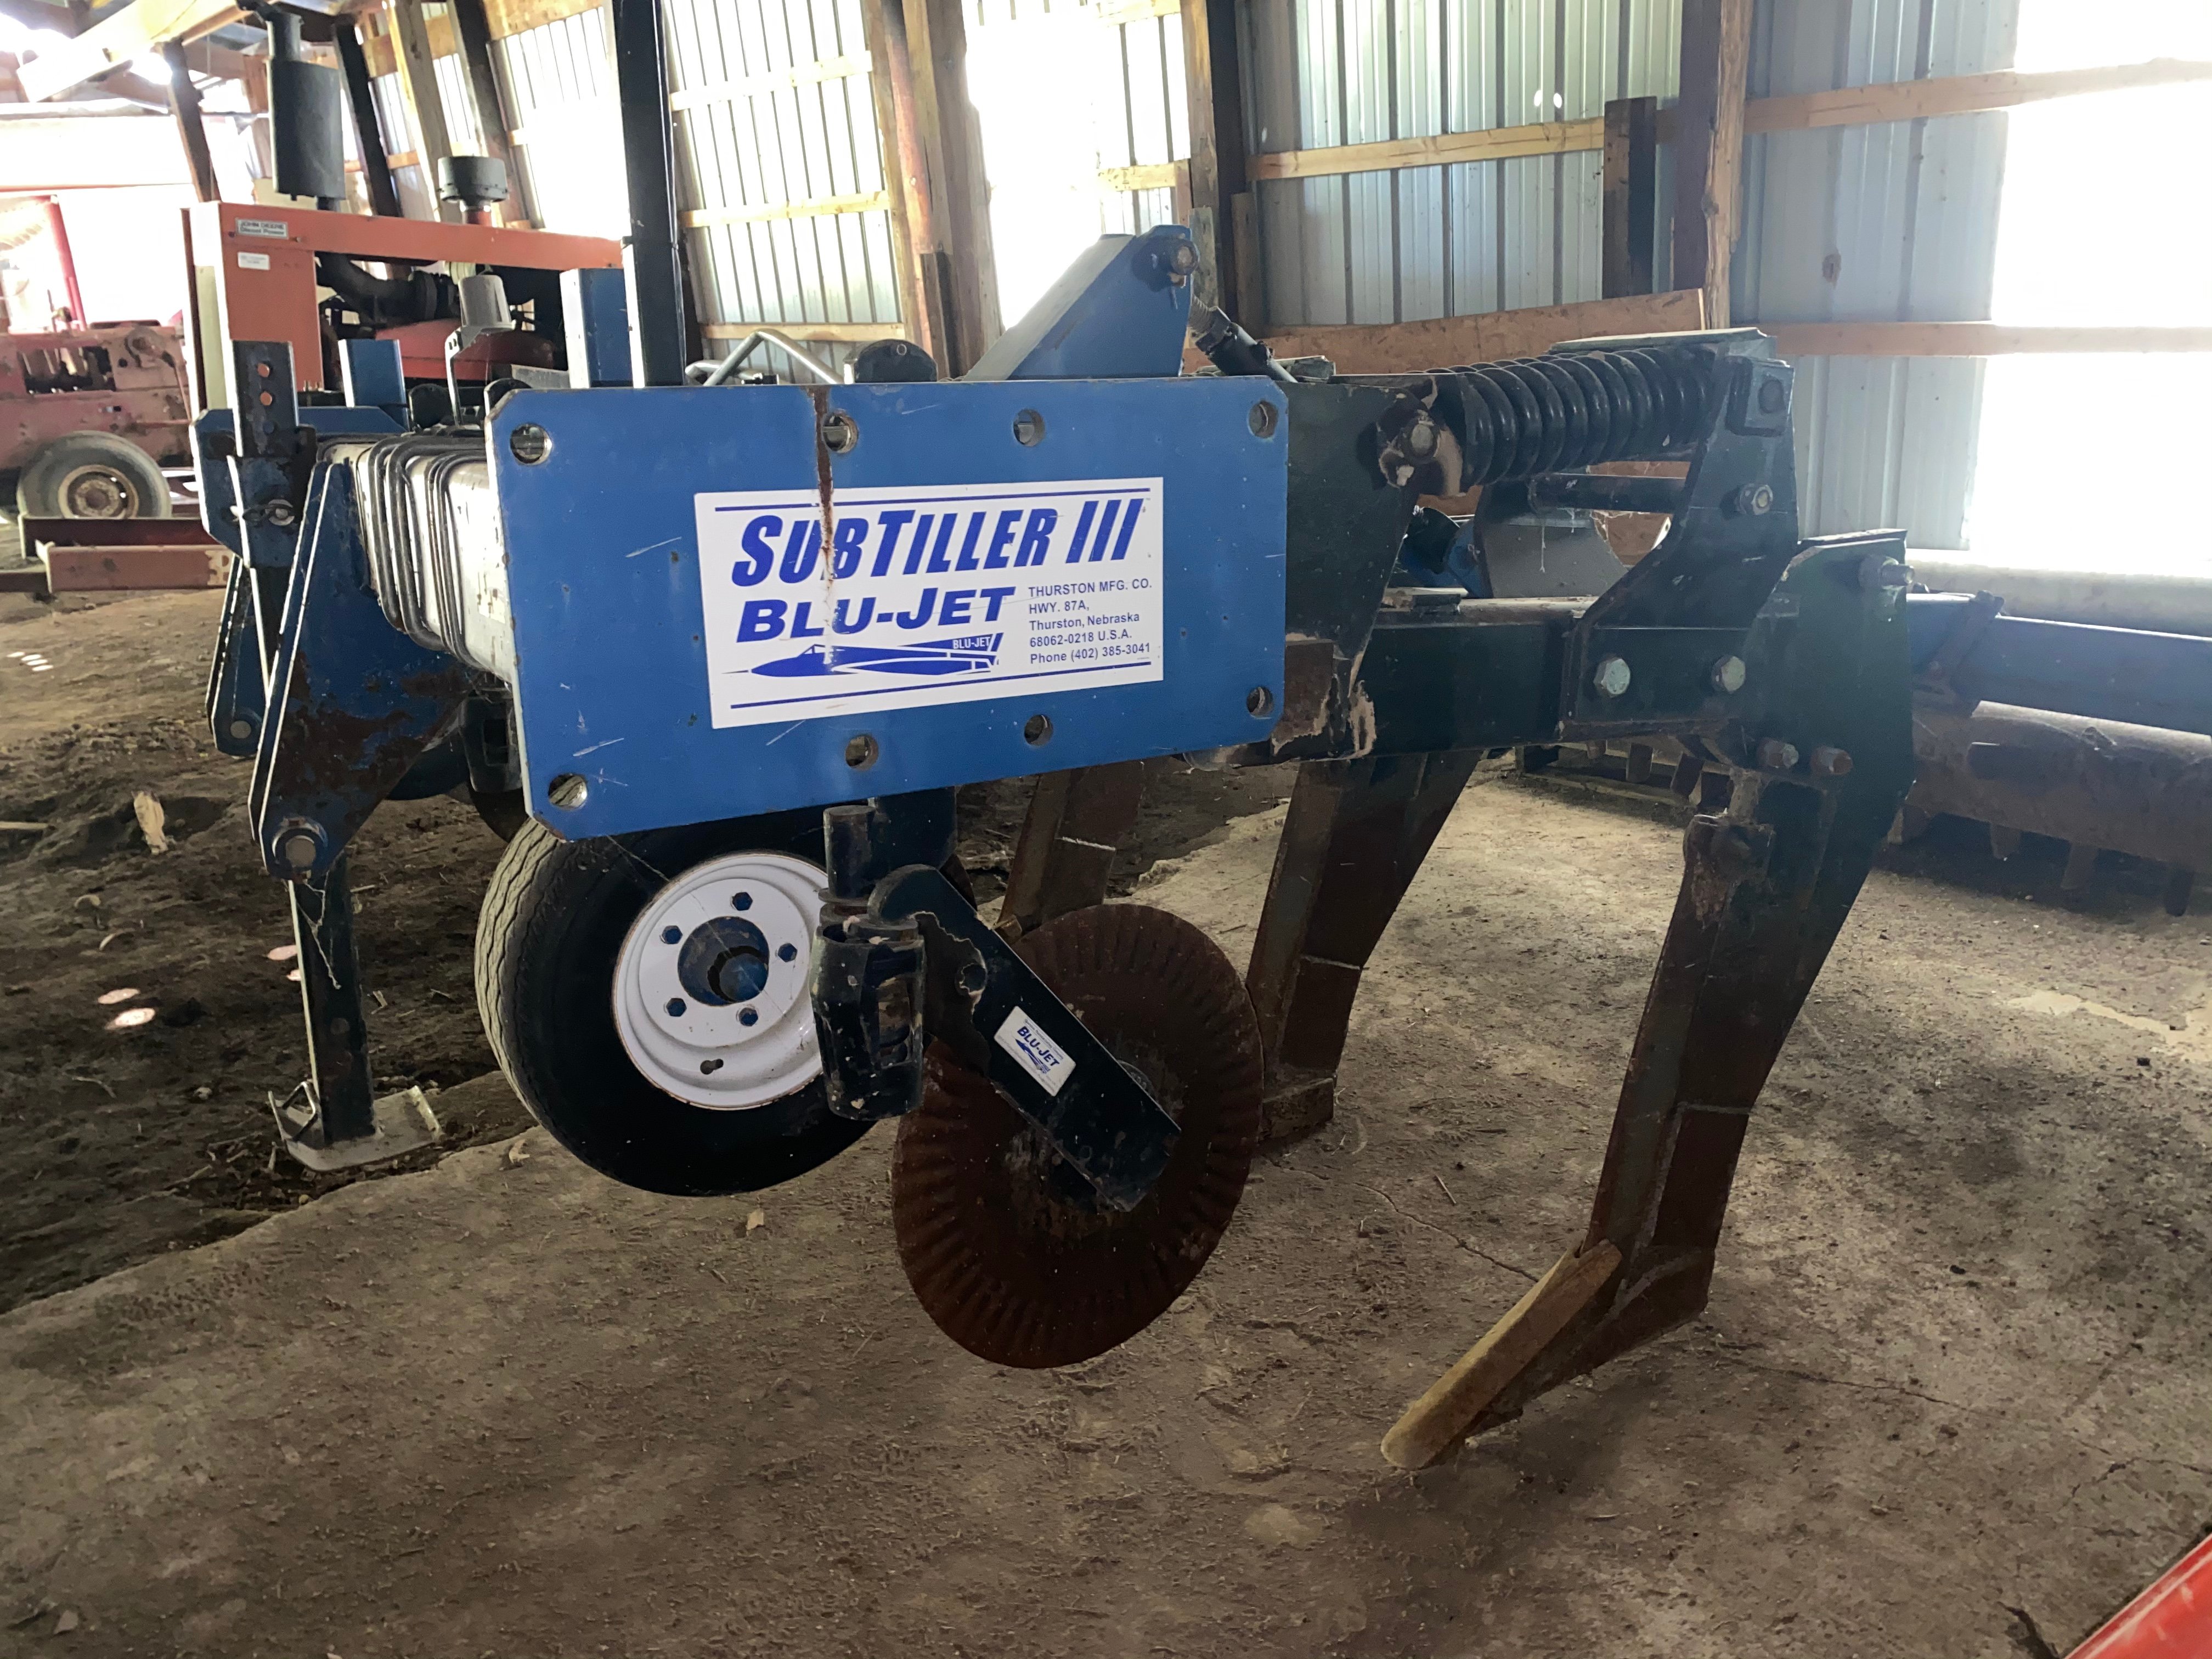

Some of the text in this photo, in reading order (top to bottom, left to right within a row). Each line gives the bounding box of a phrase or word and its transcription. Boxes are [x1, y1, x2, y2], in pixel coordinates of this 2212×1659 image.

[1065, 498, 1144, 564] III
[1029, 578, 1152, 597] THURSTON MFG. CO.
[736, 586, 1016, 643] BLU-JET
[1029, 599, 1090, 614] HWY. 87A,
[1029, 612, 1140, 631] Thurston, Nebraska
[952, 636, 991, 650] BLU-JET
[1030, 629, 1132, 648] 68062-0218 U.S.A.
[1030, 642, 1150, 664] Phone (402) 385-3041
[1017, 1025, 1060, 1066] BLU-JET
